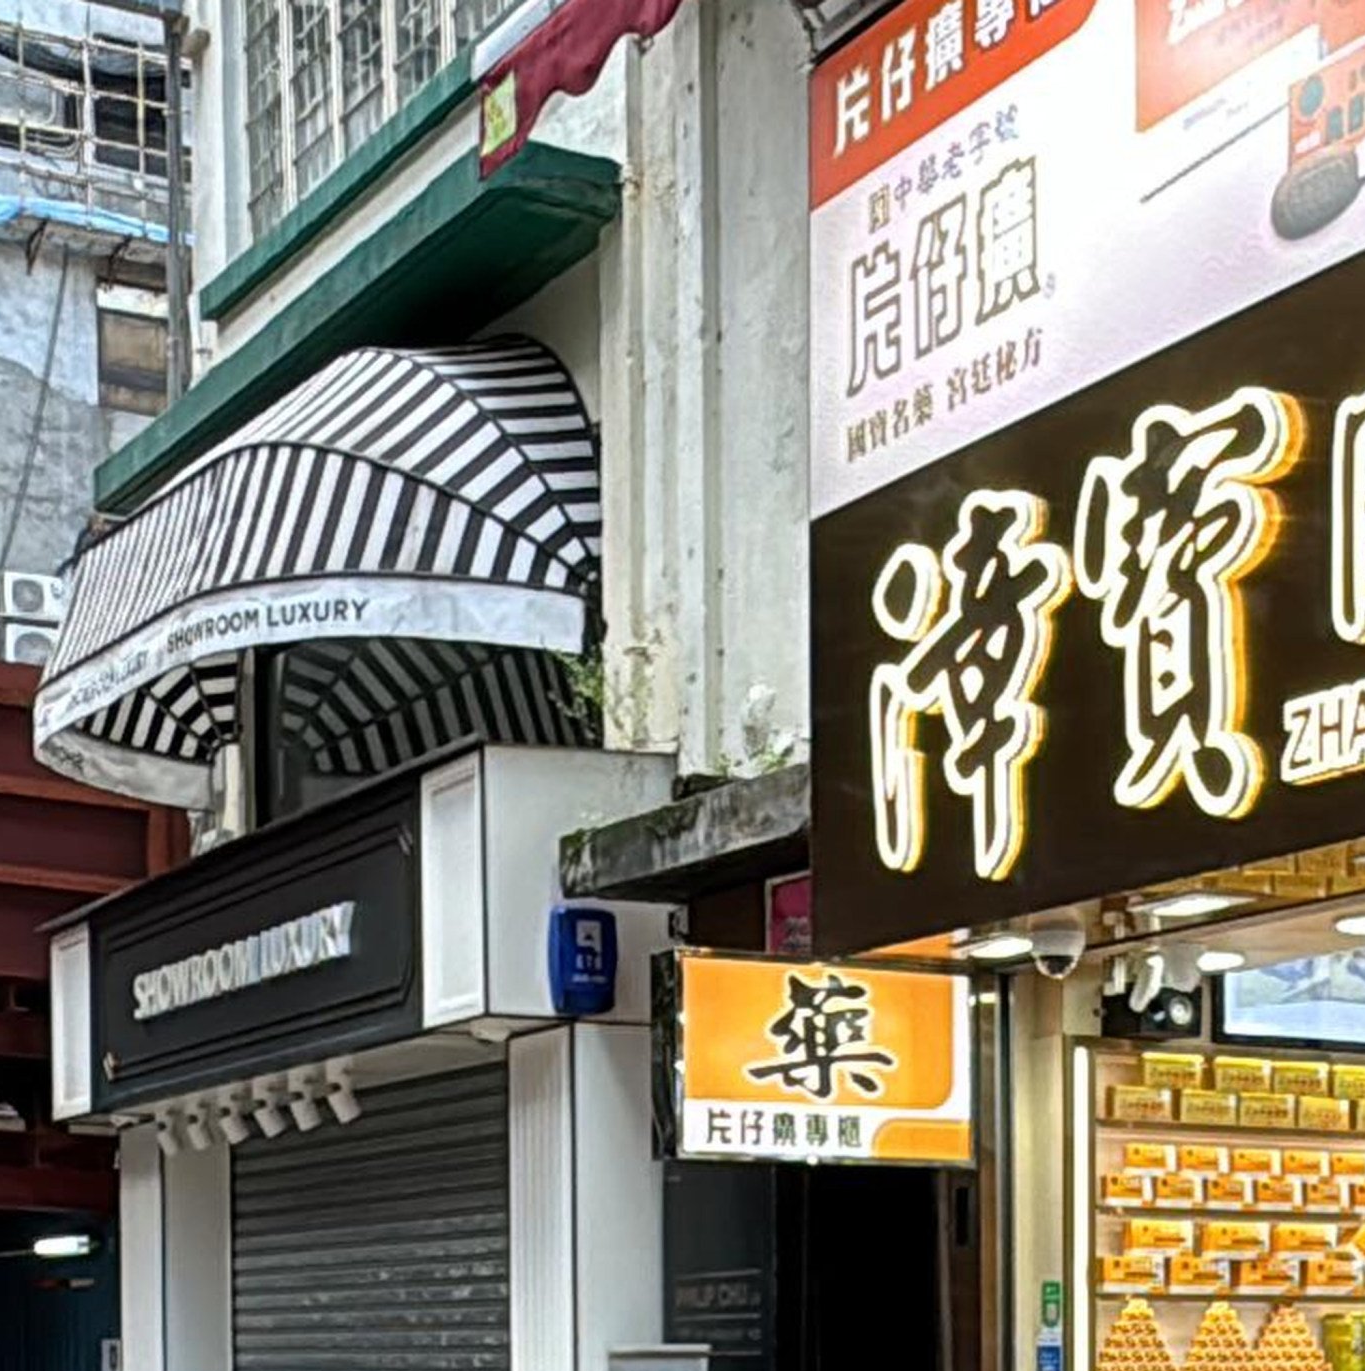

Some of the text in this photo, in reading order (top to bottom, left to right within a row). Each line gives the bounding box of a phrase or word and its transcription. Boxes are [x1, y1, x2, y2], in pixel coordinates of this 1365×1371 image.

[165, 598, 371, 653] SHOWROOM LUXURY
[133, 901, 356, 1020] SHOWROOM LUXURY
[748, 974, 894, 1098] 藥
